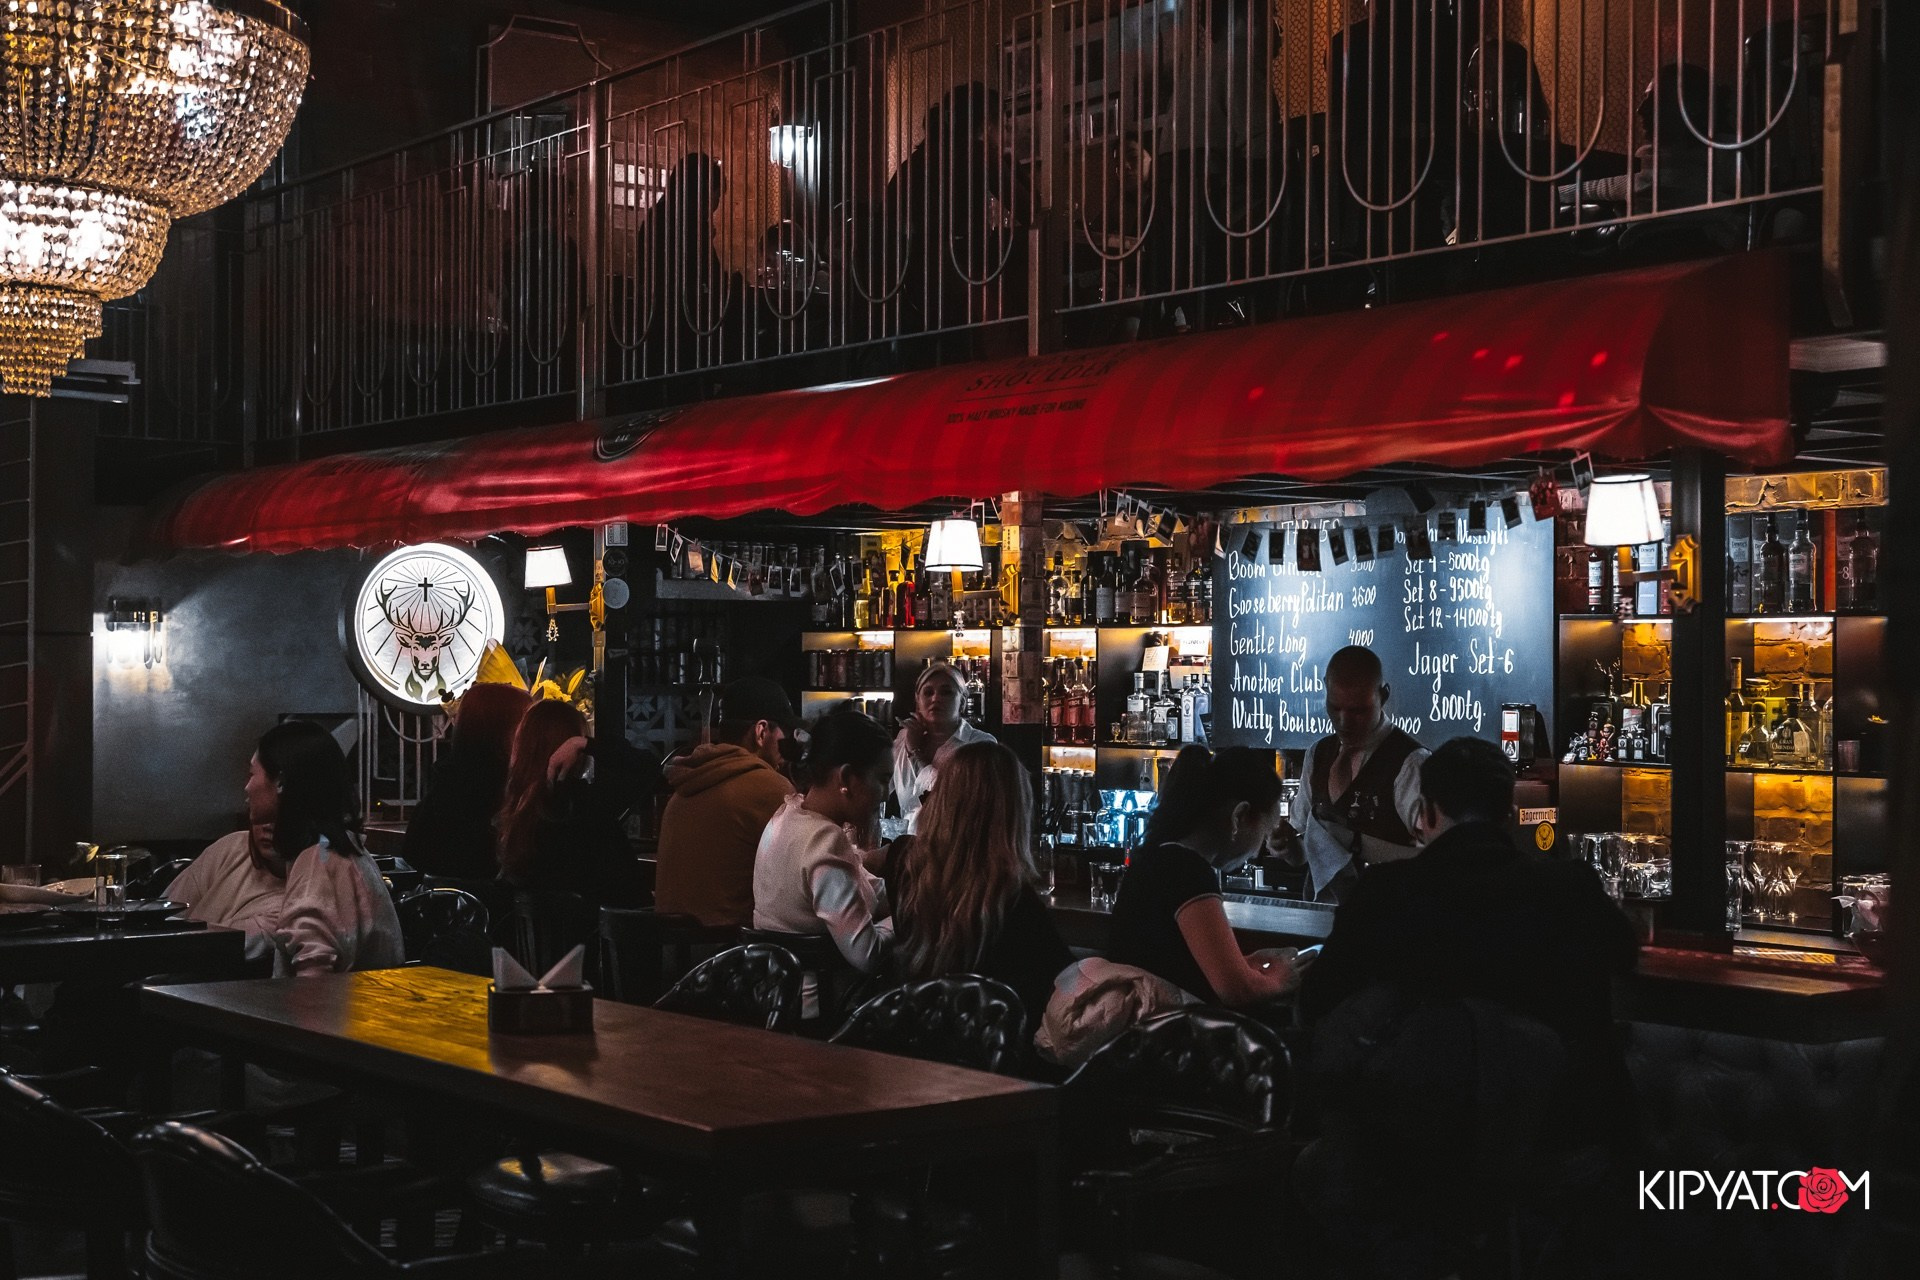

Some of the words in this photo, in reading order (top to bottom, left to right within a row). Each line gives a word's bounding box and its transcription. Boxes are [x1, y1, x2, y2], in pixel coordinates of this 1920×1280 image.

[1228, 550, 1266, 580] Boom
[1403, 575, 1424, 604] Set
[1404, 604, 1425, 632] Set
[1230, 618, 1274, 656] Gentle
[1279, 615, 1307, 667] Long
[1348, 628, 1374, 647] 4000
[1230, 659, 1284, 695] Another
[1290, 661, 1323, 693] Club
[1408, 641, 1459, 693] Jager
[1232, 696, 1273, 744] Nutty
